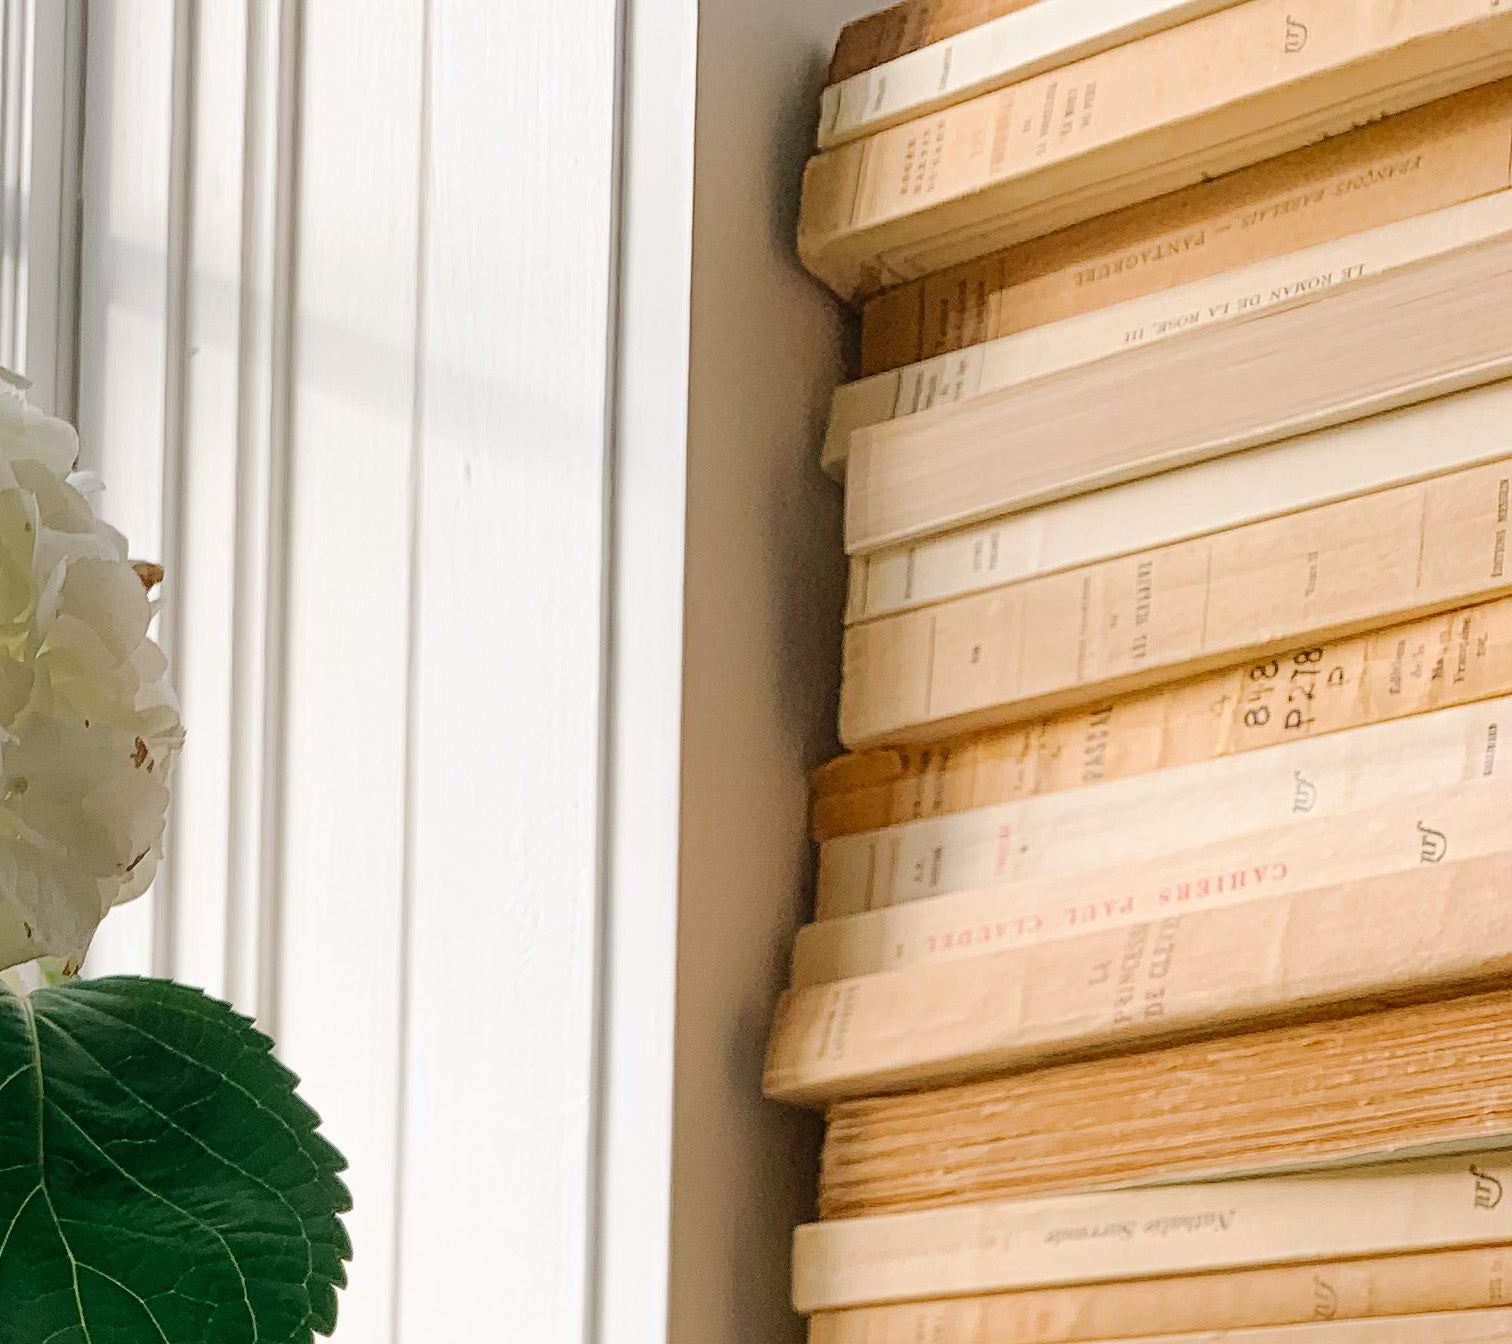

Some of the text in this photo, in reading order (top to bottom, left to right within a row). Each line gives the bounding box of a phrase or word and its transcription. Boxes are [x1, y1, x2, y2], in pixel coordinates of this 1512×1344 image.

[1073, 230, 1206, 287] PANTAGRUEL
[1340, 264, 1365, 280] LE
[1237, 294, 1261, 310] DE
[1269, 272, 1332, 301] ROMAN
[1207, 303, 1230, 318] LA
[1243, 660, 1279, 728] 848
[1416, 820, 1448, 864] nrf
[1158, 860, 1289, 907] CAHIERS
[1063, 895, 1136, 926] PAUL
[925, 913, 1043, 954] CLAUDEL
[1467, 1163, 1504, 1211] nrf
